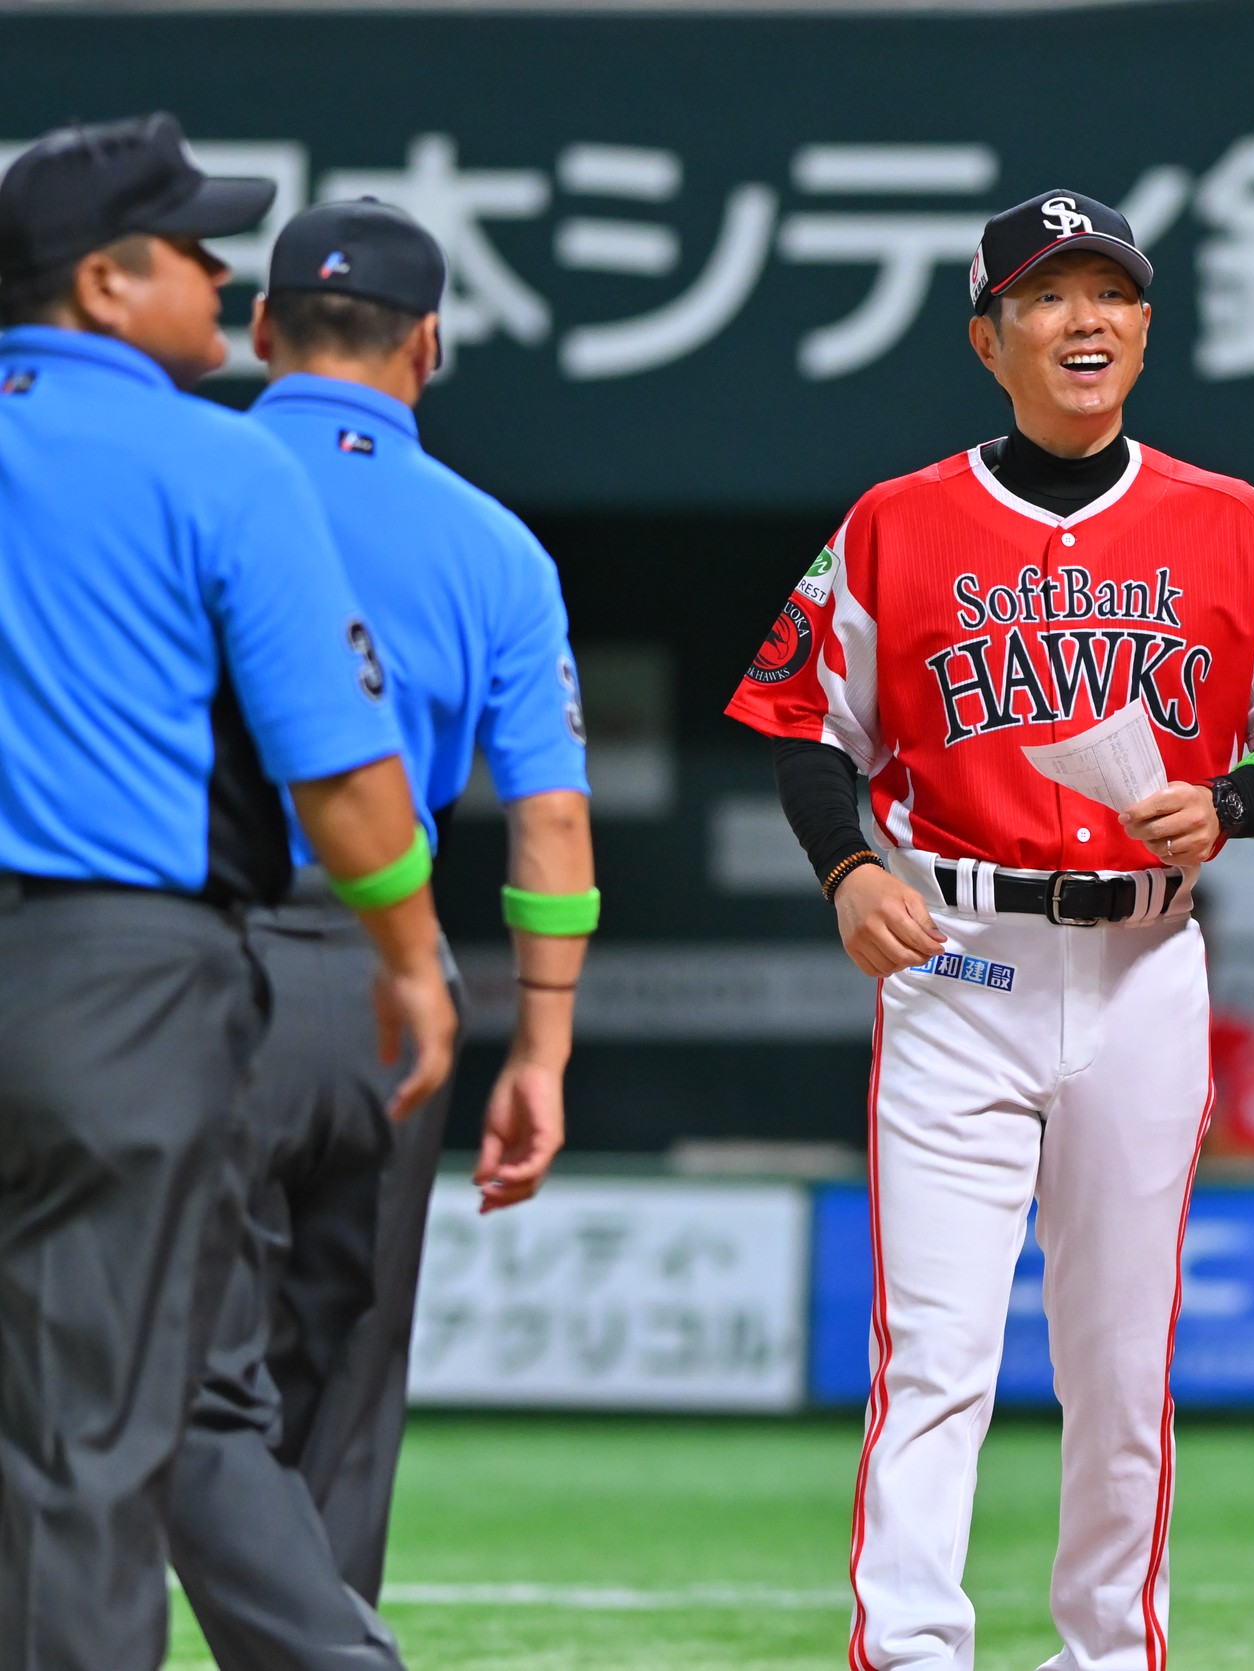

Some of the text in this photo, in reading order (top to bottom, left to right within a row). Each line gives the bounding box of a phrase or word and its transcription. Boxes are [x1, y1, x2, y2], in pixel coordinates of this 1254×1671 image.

[954, 564, 1183, 630] SoftBank
[348, 619, 385, 702] 3
[925, 626, 1212, 748] HAWKS
